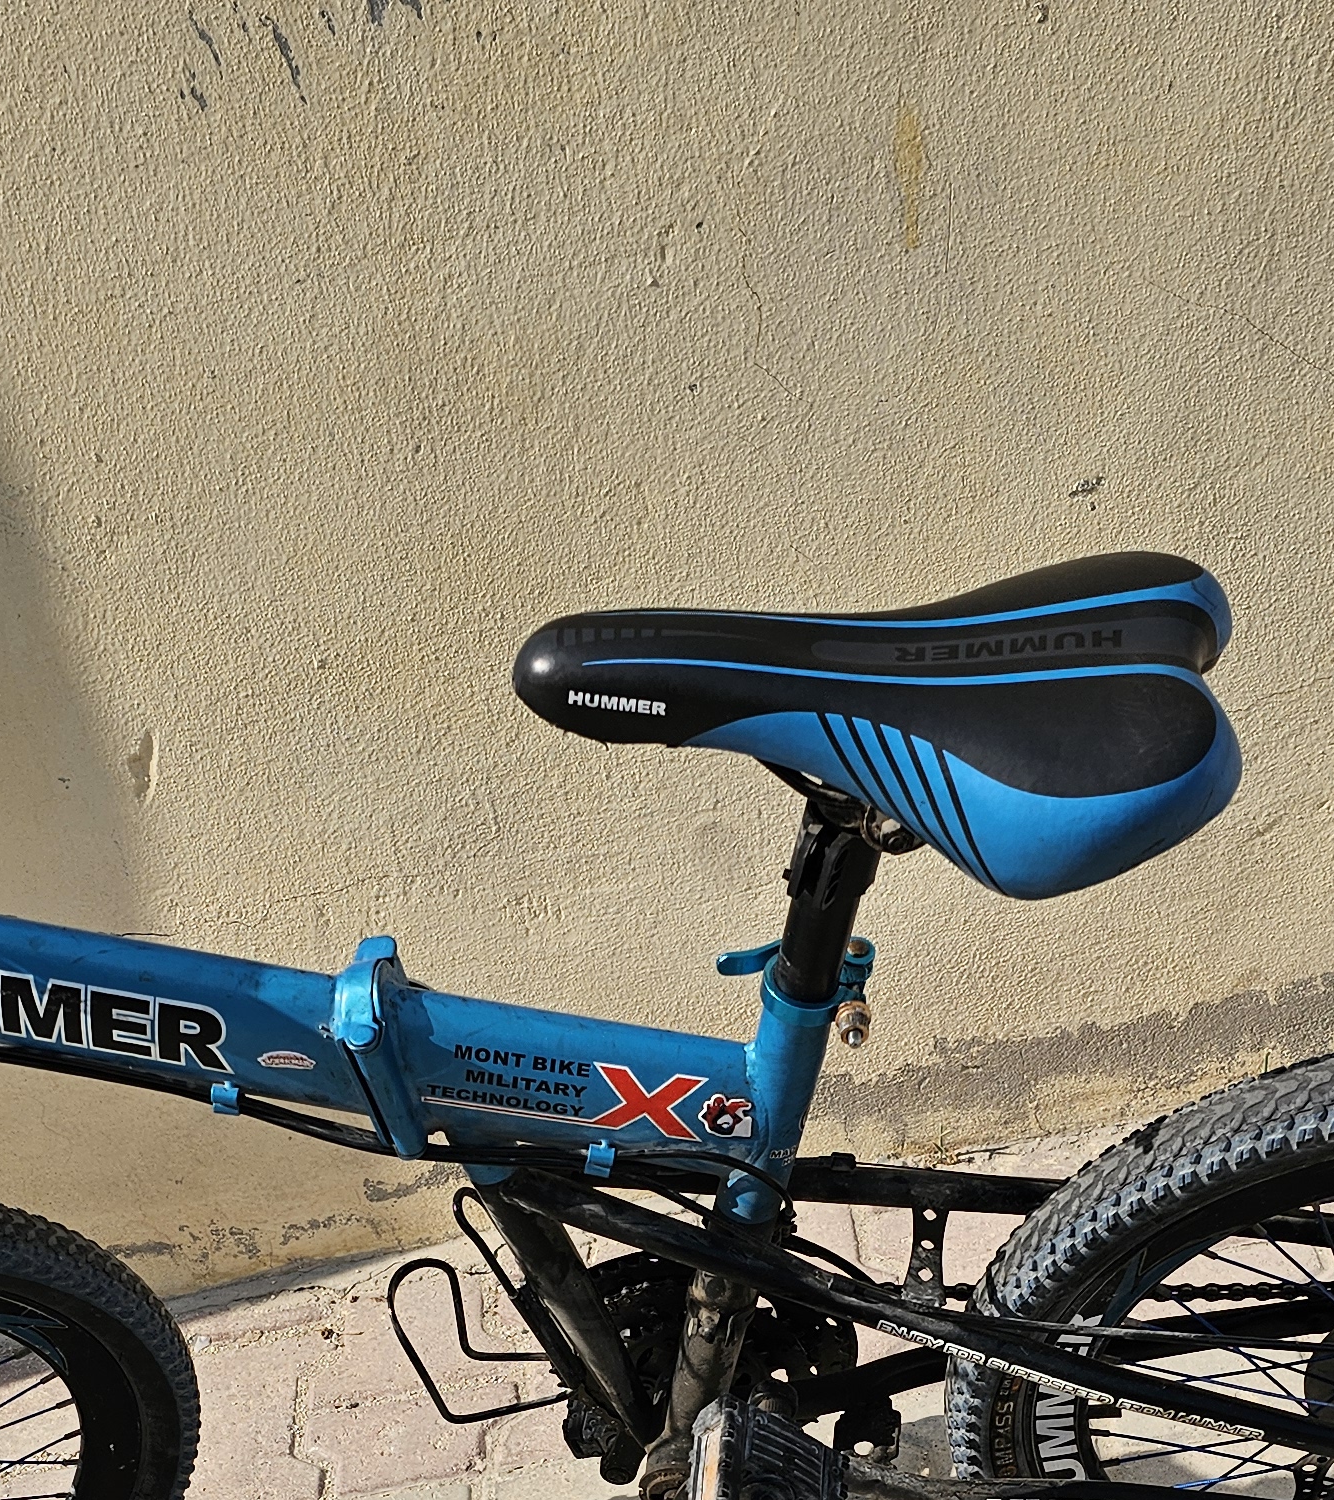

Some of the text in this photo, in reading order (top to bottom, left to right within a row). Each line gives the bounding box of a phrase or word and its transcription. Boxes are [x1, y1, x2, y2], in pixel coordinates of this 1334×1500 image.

[895, 630, 1124, 663] HUMMER
[568, 690, 667, 717] HUMMER
[454, 1044, 592, 1078] MONT BIKE
[427, 1084, 586, 1117] TECHNOLOGY
[465, 1069, 588, 1099] MILITARY
[591, 1061, 709, 1142] X
[877, 1320, 943, 1352] ENJOY
[943, 1343, 985, 1366] FOR
[986, 1355, 1115, 1407] SUPERSPEED
[1115, 1397, 1173, 1420] FROM
[1173, 1411, 1265, 1441] HUMMER
